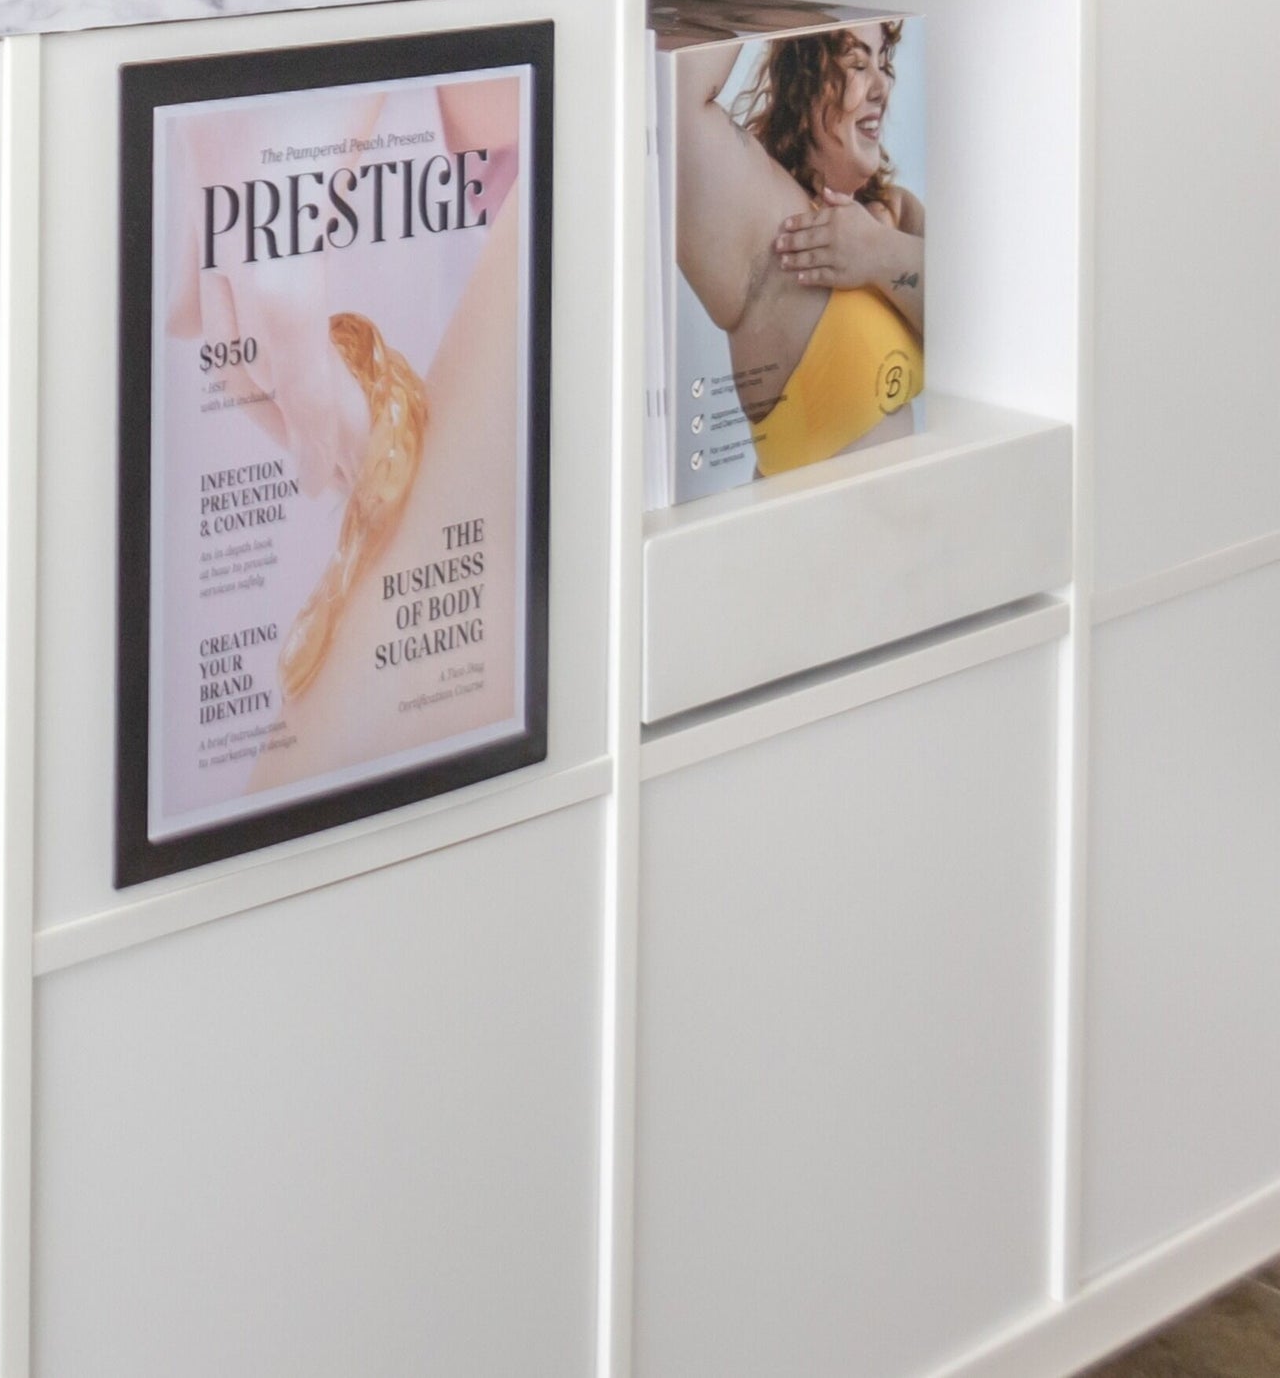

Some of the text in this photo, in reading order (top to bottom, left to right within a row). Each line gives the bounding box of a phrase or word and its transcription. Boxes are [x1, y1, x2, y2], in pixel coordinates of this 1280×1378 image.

[260, 130, 436, 164] The Pampered Peach Presents
[201, 148, 488, 270] PRESTIGE
[200, 337, 257, 374] $950
[200, 459, 284, 492] INFECTION
[200, 478, 300, 515] PREVENTION
[200, 504, 287, 537] & CONTROL
[442, 518, 485, 551] THE
[382, 551, 484, 600] BUSINESS
[396, 583, 485, 630] OF BODY
[199, 623, 278, 658] CREATING
[374, 618, 484, 670] SUGARING
[199, 654, 243, 680] YOUR
[200, 673, 253, 703] BRAND
[199, 689, 272, 725] IDENTITY
